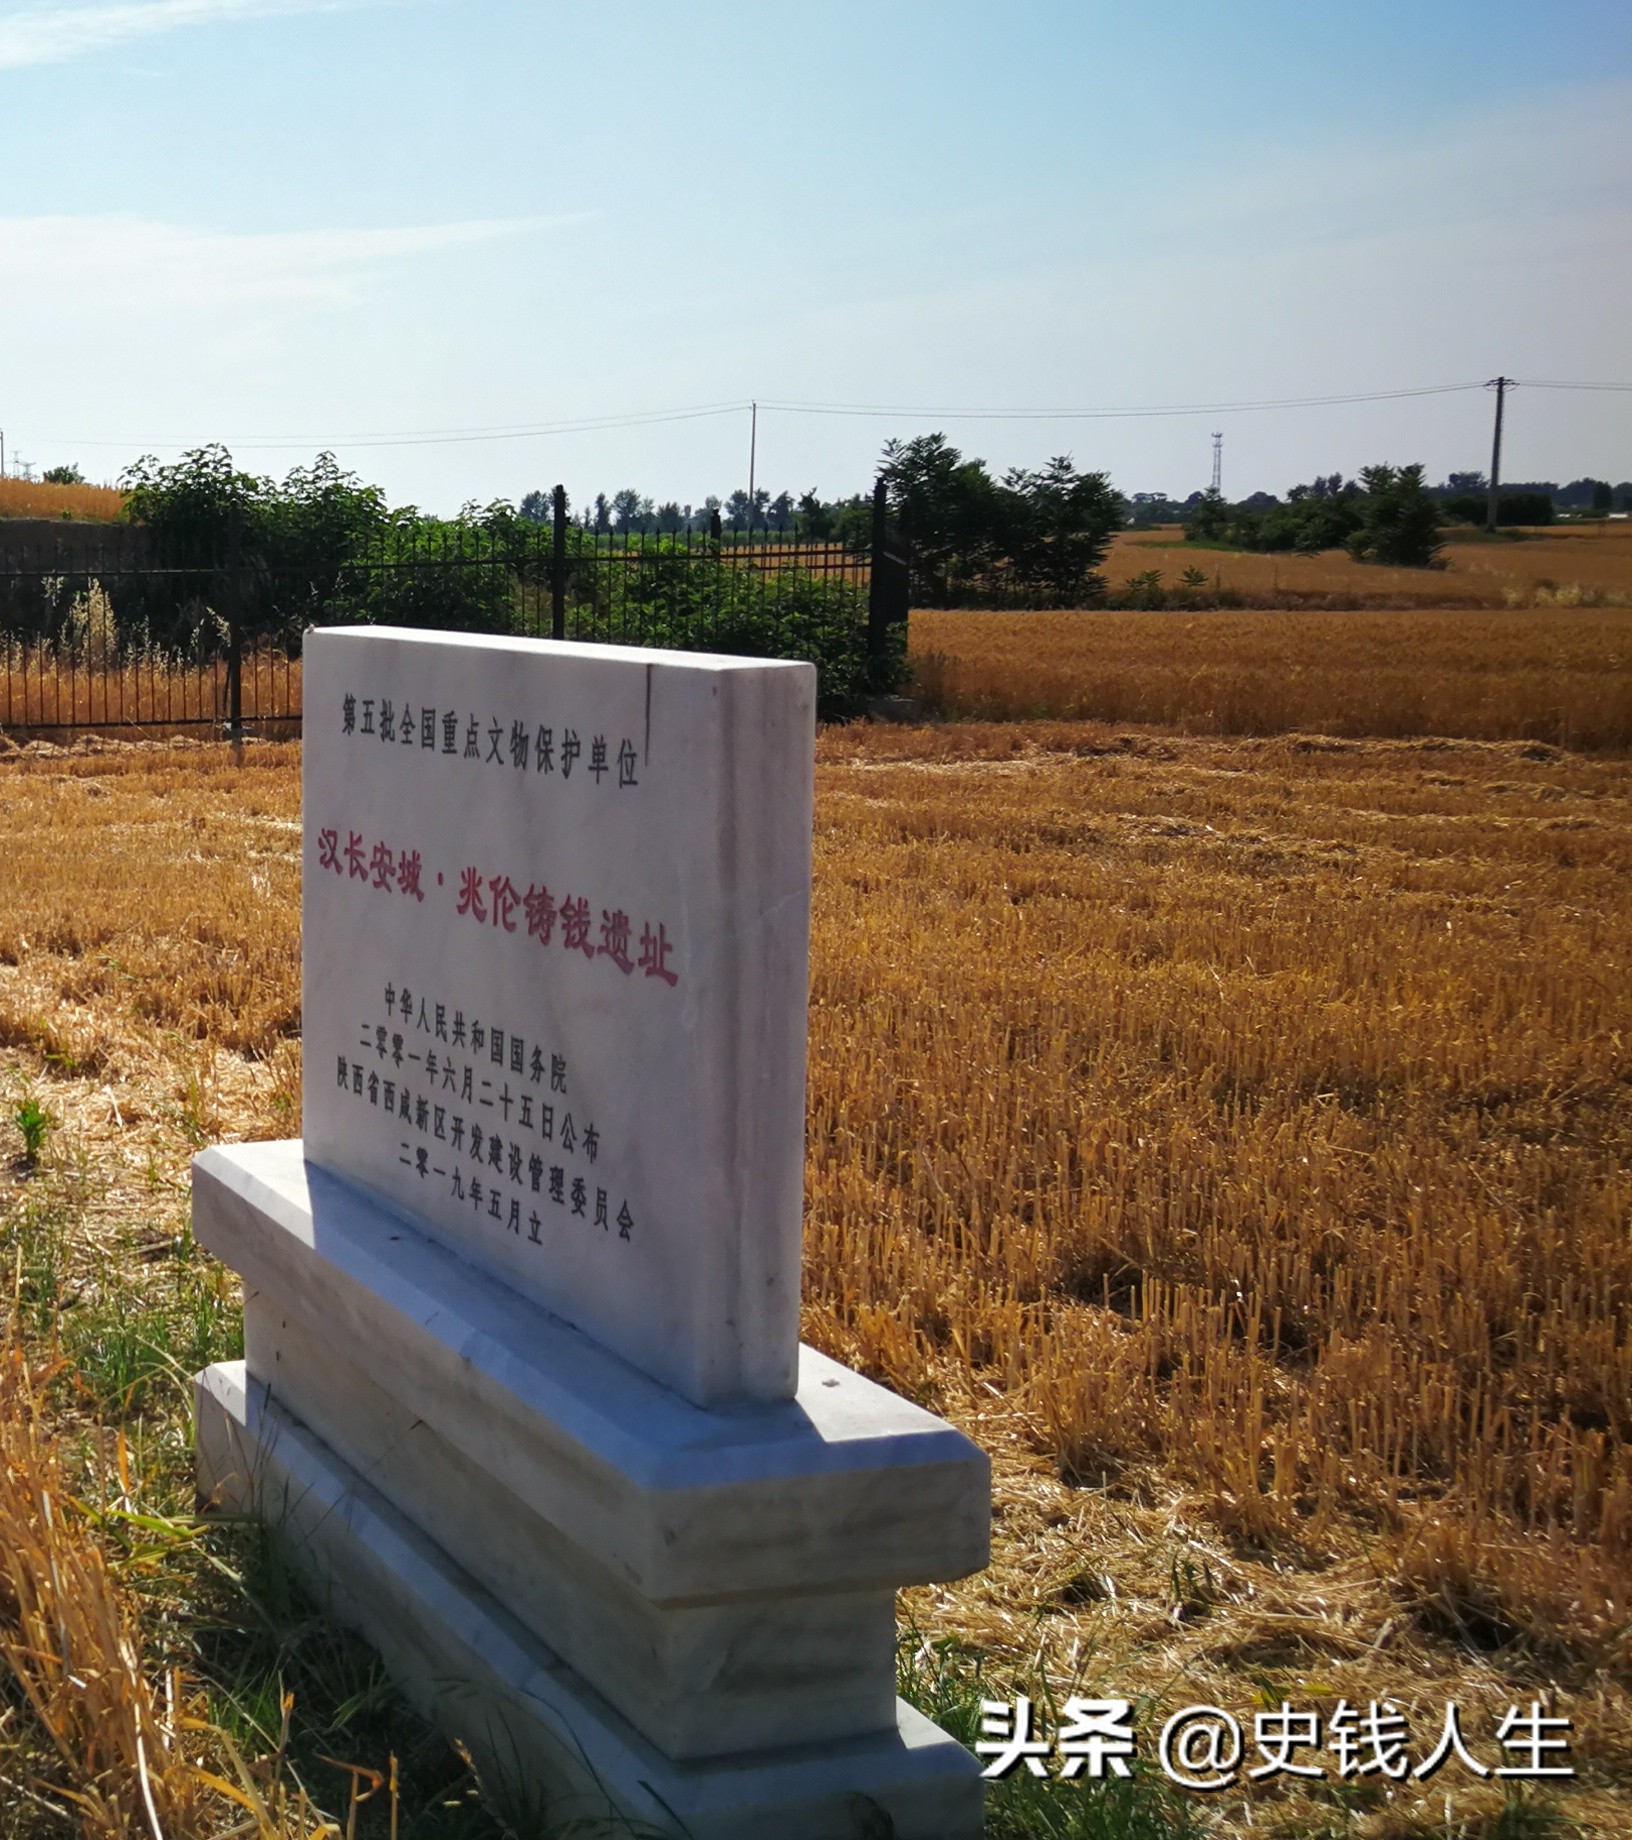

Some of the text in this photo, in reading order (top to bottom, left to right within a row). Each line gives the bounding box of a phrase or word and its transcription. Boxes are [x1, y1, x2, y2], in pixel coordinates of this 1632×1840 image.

[342, 693, 639, 788] 第五批全国重点文物保护单位
[318, 827, 679, 987] 汉长安城·兆伦铸钱遗址
[359, 1023, 601, 1164] 二零零一年六月二十五日公布
[384, 982, 567, 1094] 中华人民共和国国务院
[336, 1055, 635, 1242] 陕西省西咸新区开发建设管理委员会
[398, 1142, 544, 1246] 二零一九年五月立
